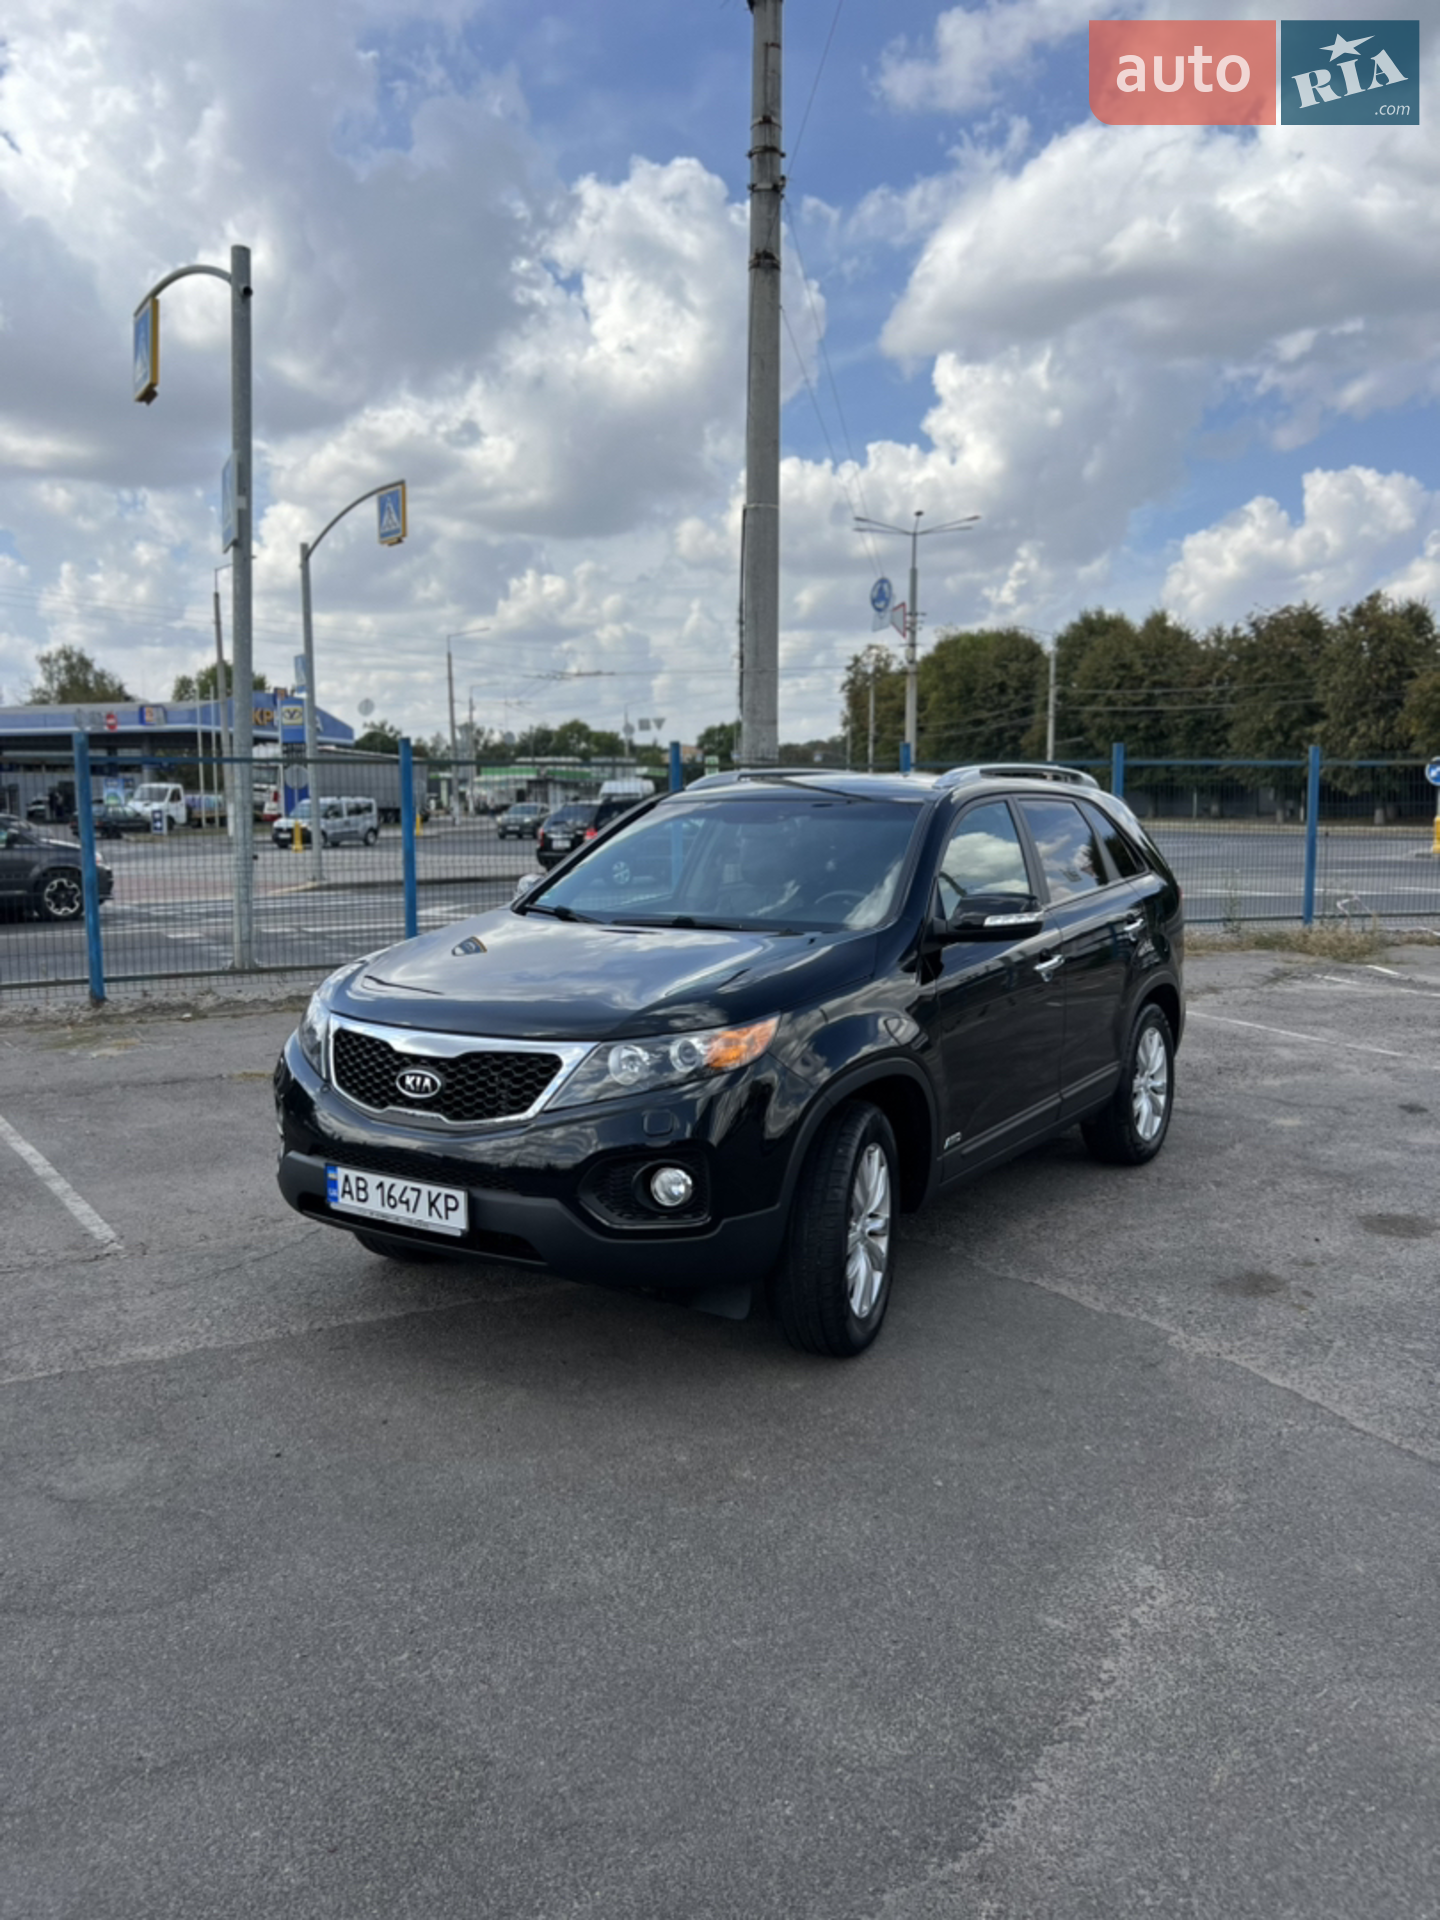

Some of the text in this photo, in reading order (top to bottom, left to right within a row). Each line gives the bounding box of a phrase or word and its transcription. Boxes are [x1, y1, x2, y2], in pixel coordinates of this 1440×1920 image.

[405, 1075, 432, 1092] KIA
[341, 1174, 369, 1203] AB
[376, 1181, 422, 1214] 1647
[428, 1190, 460, 1221] KP
